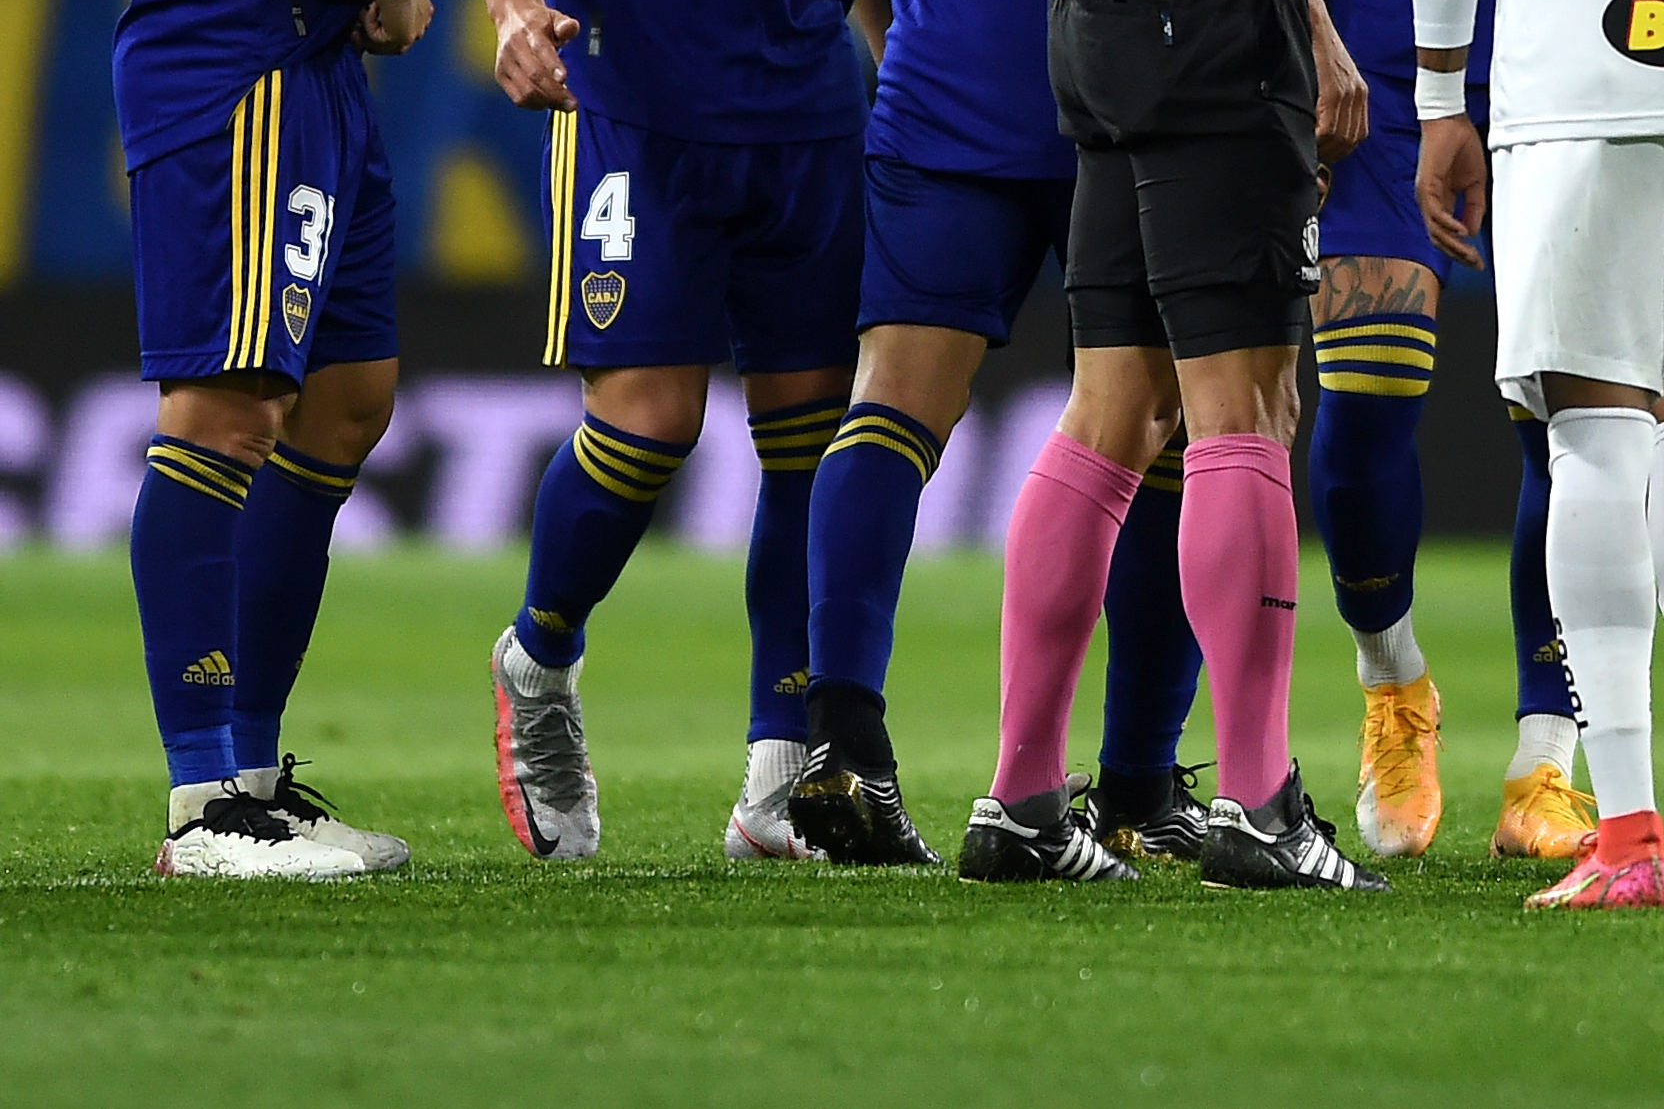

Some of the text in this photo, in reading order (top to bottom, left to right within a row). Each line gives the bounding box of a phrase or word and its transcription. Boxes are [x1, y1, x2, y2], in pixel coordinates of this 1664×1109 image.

[581, 171, 635, 262] 4
[587, 291, 618, 304] CABJ
[183, 671, 235, 686] adidas
